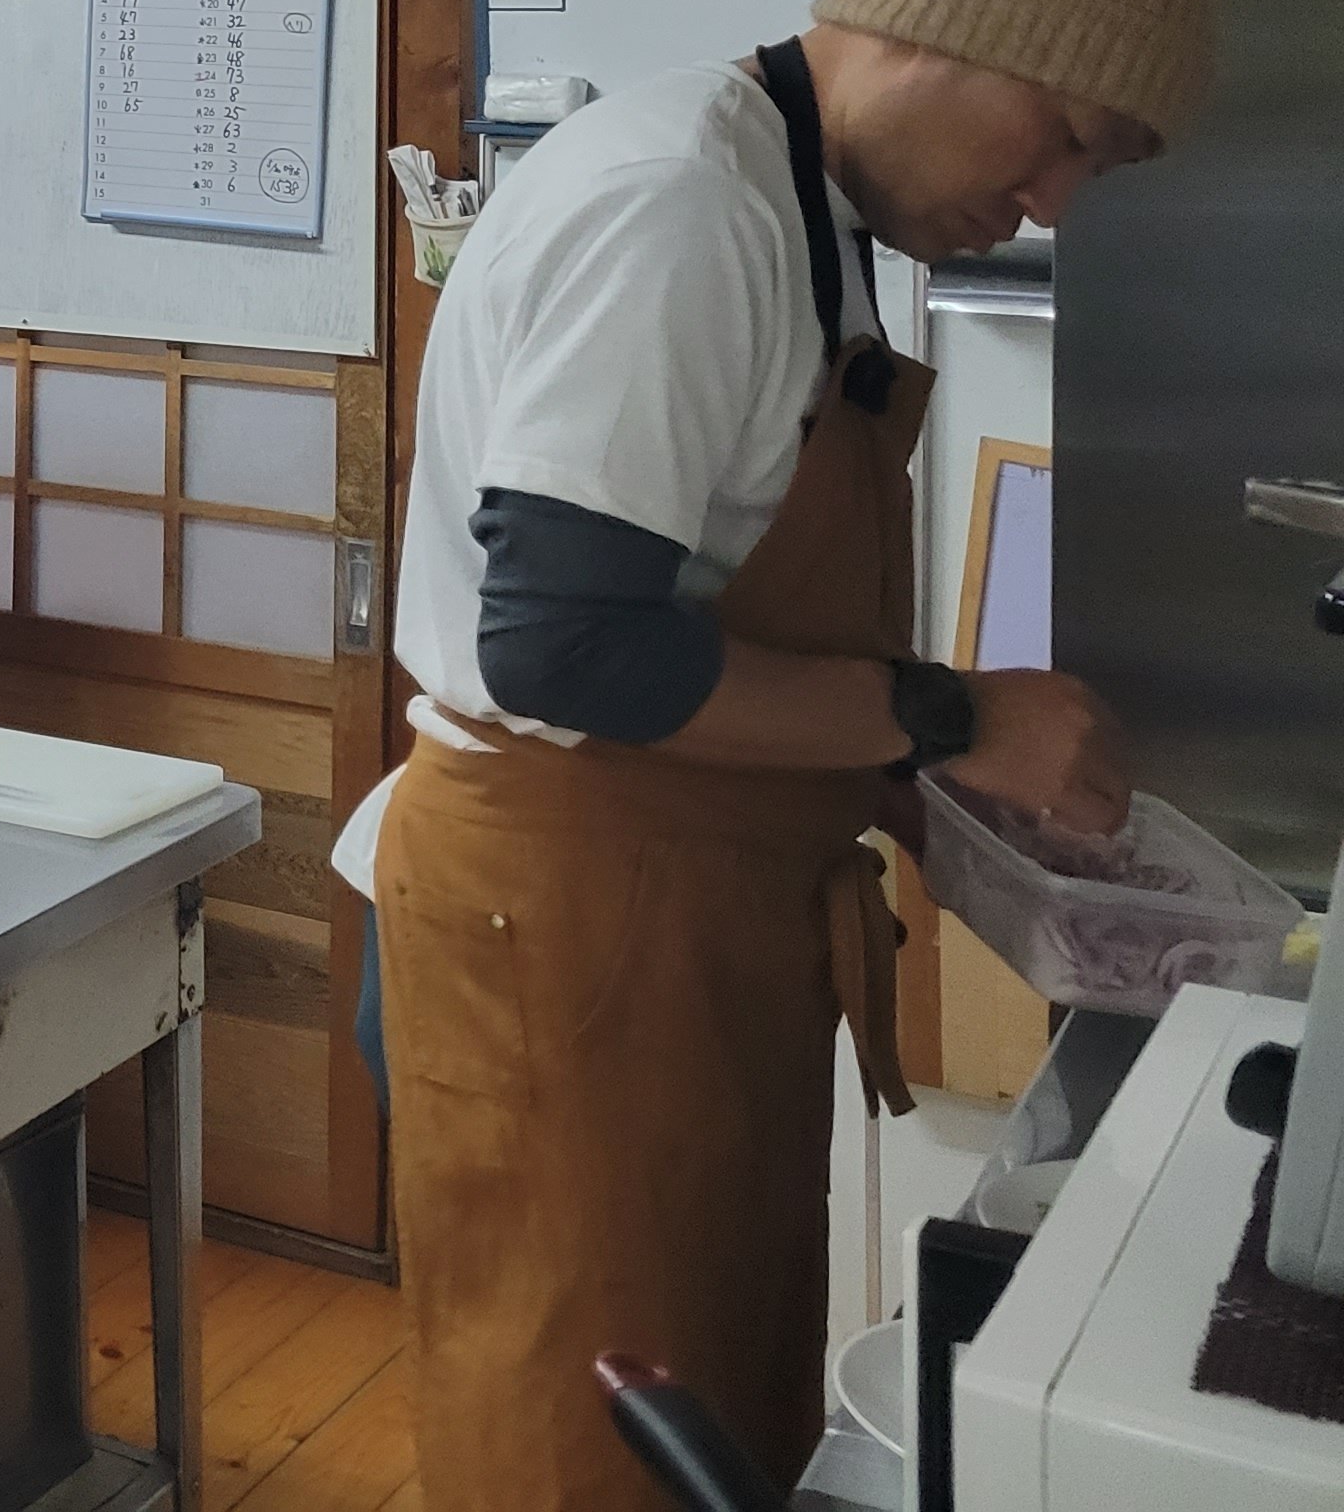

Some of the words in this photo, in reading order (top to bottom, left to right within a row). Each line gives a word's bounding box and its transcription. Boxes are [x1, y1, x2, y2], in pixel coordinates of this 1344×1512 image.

[207, 0, 219, 8] 20
[100, 13, 107, 22] 5
[119, 11, 137, 25] 47
[205, 17, 217, 26] 21
[226, 14, 246, 28] 32
[100, 31, 106, 40] 6
[118, 30, 135, 41] 23
[205, 35, 218, 45] 22
[228, 32, 244, 49] 46
[99, 48, 106, 56] 7
[120, 44, 135, 61] 68
[205, 54, 217, 63] 23
[226, 50, 245, 66] 48
[99, 66, 105, 75] 8
[204, 72, 216, 81] 24
[226, 67, 244, 85] 73
[99, 82, 105, 91] 9
[123, 81, 138, 93] 27
[204, 88, 216, 98] 25
[229, 87, 240, 102] 8
[97, 100, 107, 110] 10
[124, 98, 143, 113] 65
[203, 107, 215, 117] 26
[224, 106, 246, 120] 25
[96, 118, 106, 127] 11
[202, 125, 214, 134] 27
[223, 123, 241, 138] 63
[95, 136, 106, 145] 12
[202, 143, 214, 153] 28
[227, 143, 237, 153] 2
[95, 153, 106, 163] 13
[201, 161, 213, 170] 29
[229, 159, 238, 173] 3
[95, 171, 105, 180] 14
[200, 179, 213, 189] 30
[227, 177, 236, 193] 6
[94, 188, 104, 198] 15
[200, 196, 211, 206] 31
